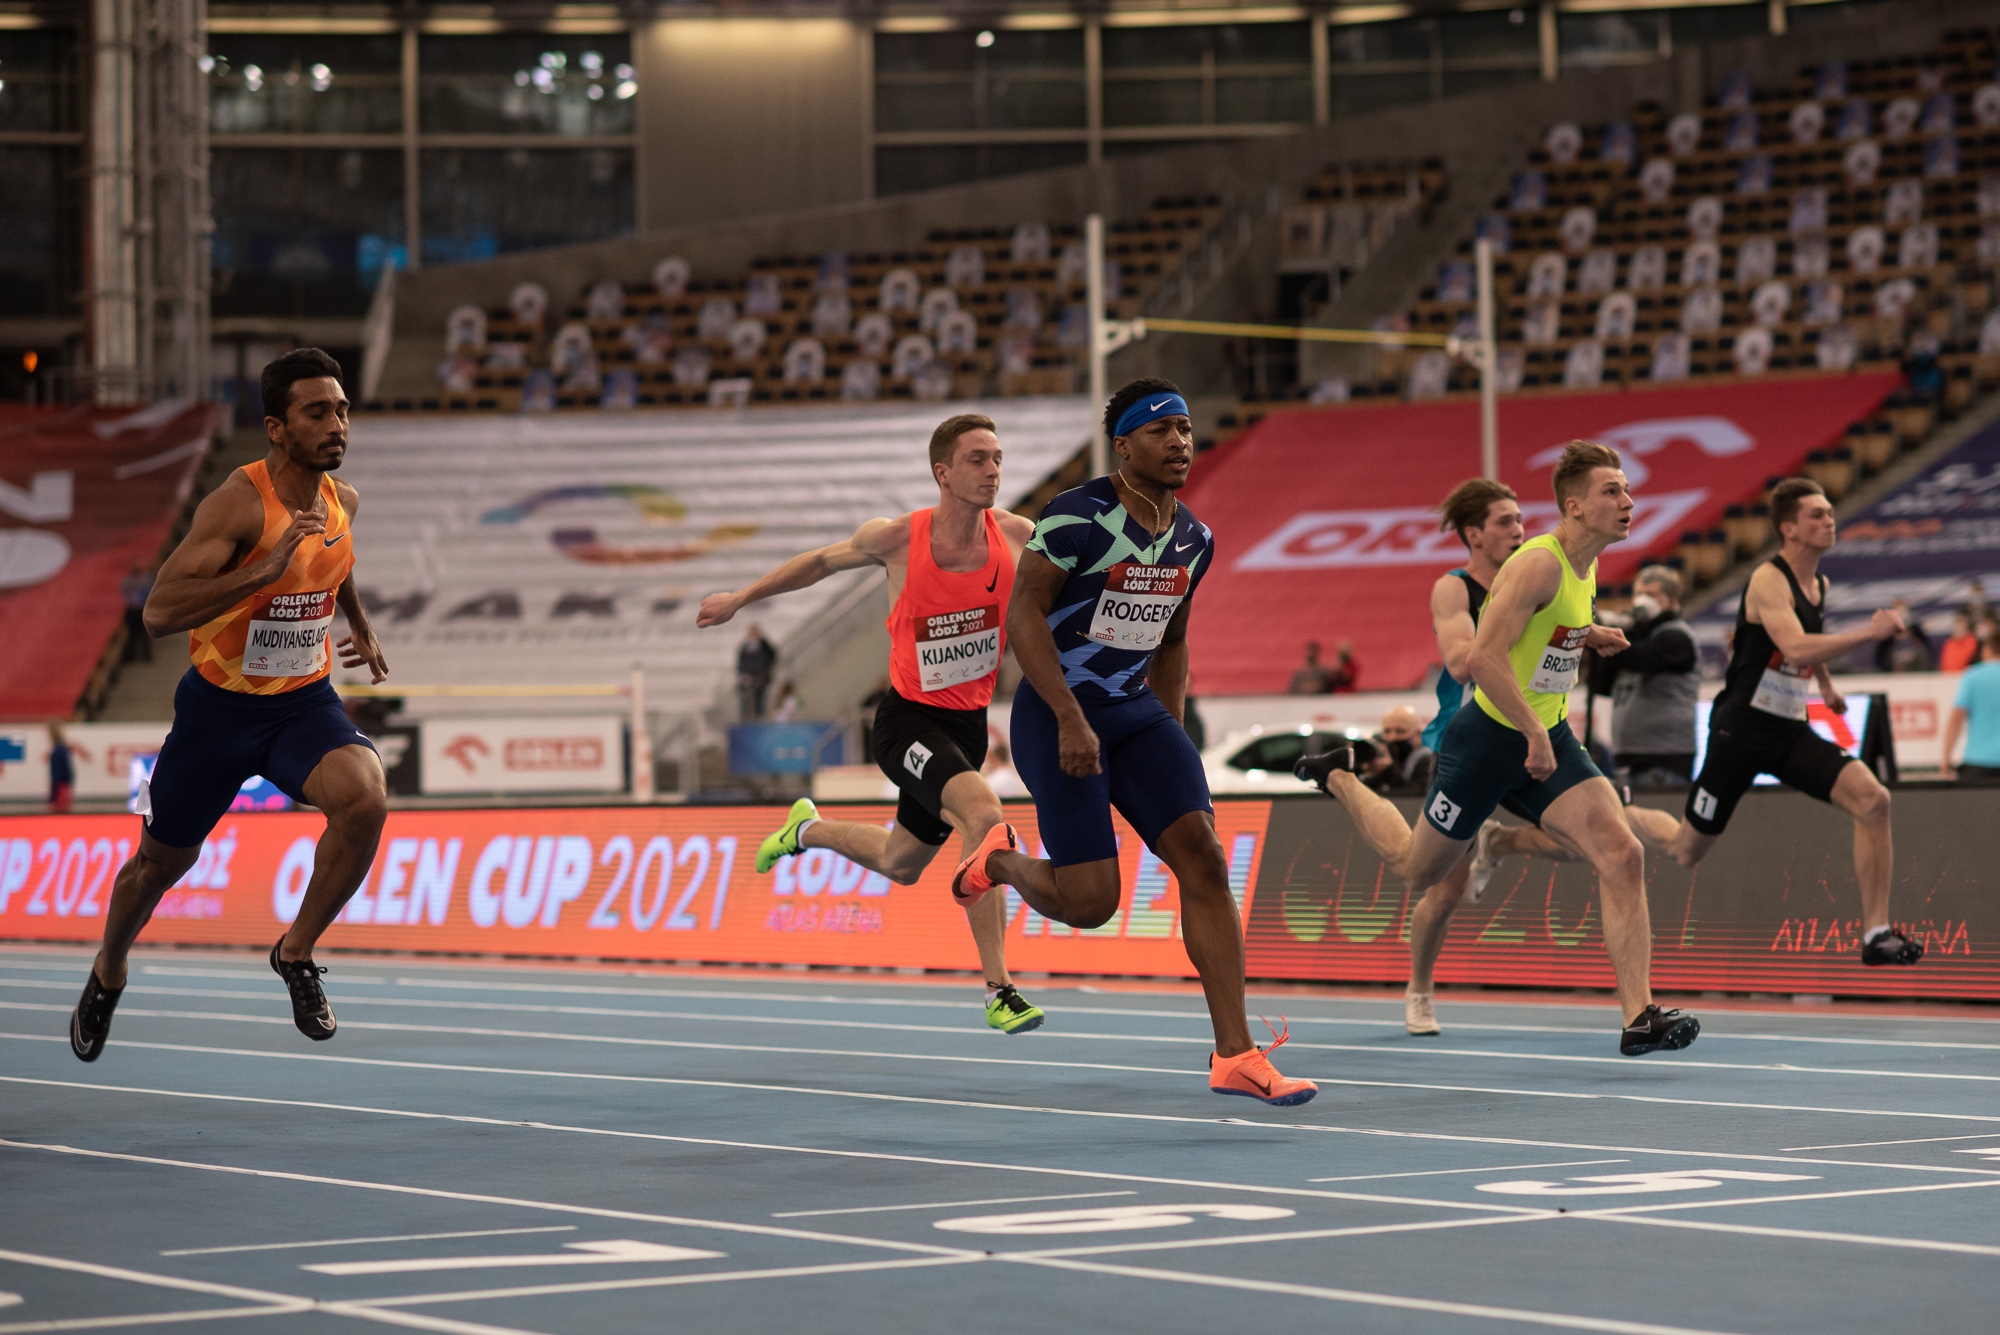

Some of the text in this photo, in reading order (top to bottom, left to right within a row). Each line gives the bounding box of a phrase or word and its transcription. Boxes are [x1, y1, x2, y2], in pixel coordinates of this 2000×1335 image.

[1126, 566, 1179, 579] ORLEN CUP
[1123, 578, 1175, 592] ŁÓDŹ 2021
[272, 592, 328, 606] ORLEN CUP
[269, 605, 324, 618] ŁÓDŹ 2021
[927, 608, 986, 627] ORLEN CUP
[929, 620, 985, 638] ŁÓDŹ 2021
[922, 632, 997, 666] KIJANOVIĆ
[909, 748, 924, 771] 4
[1435, 800, 1452, 823] 3
[1701, 795, 1708, 814] 1
[273, 835, 738, 931] OLEN CUP 2021
[1771, 917, 1861, 952] ATLAS
